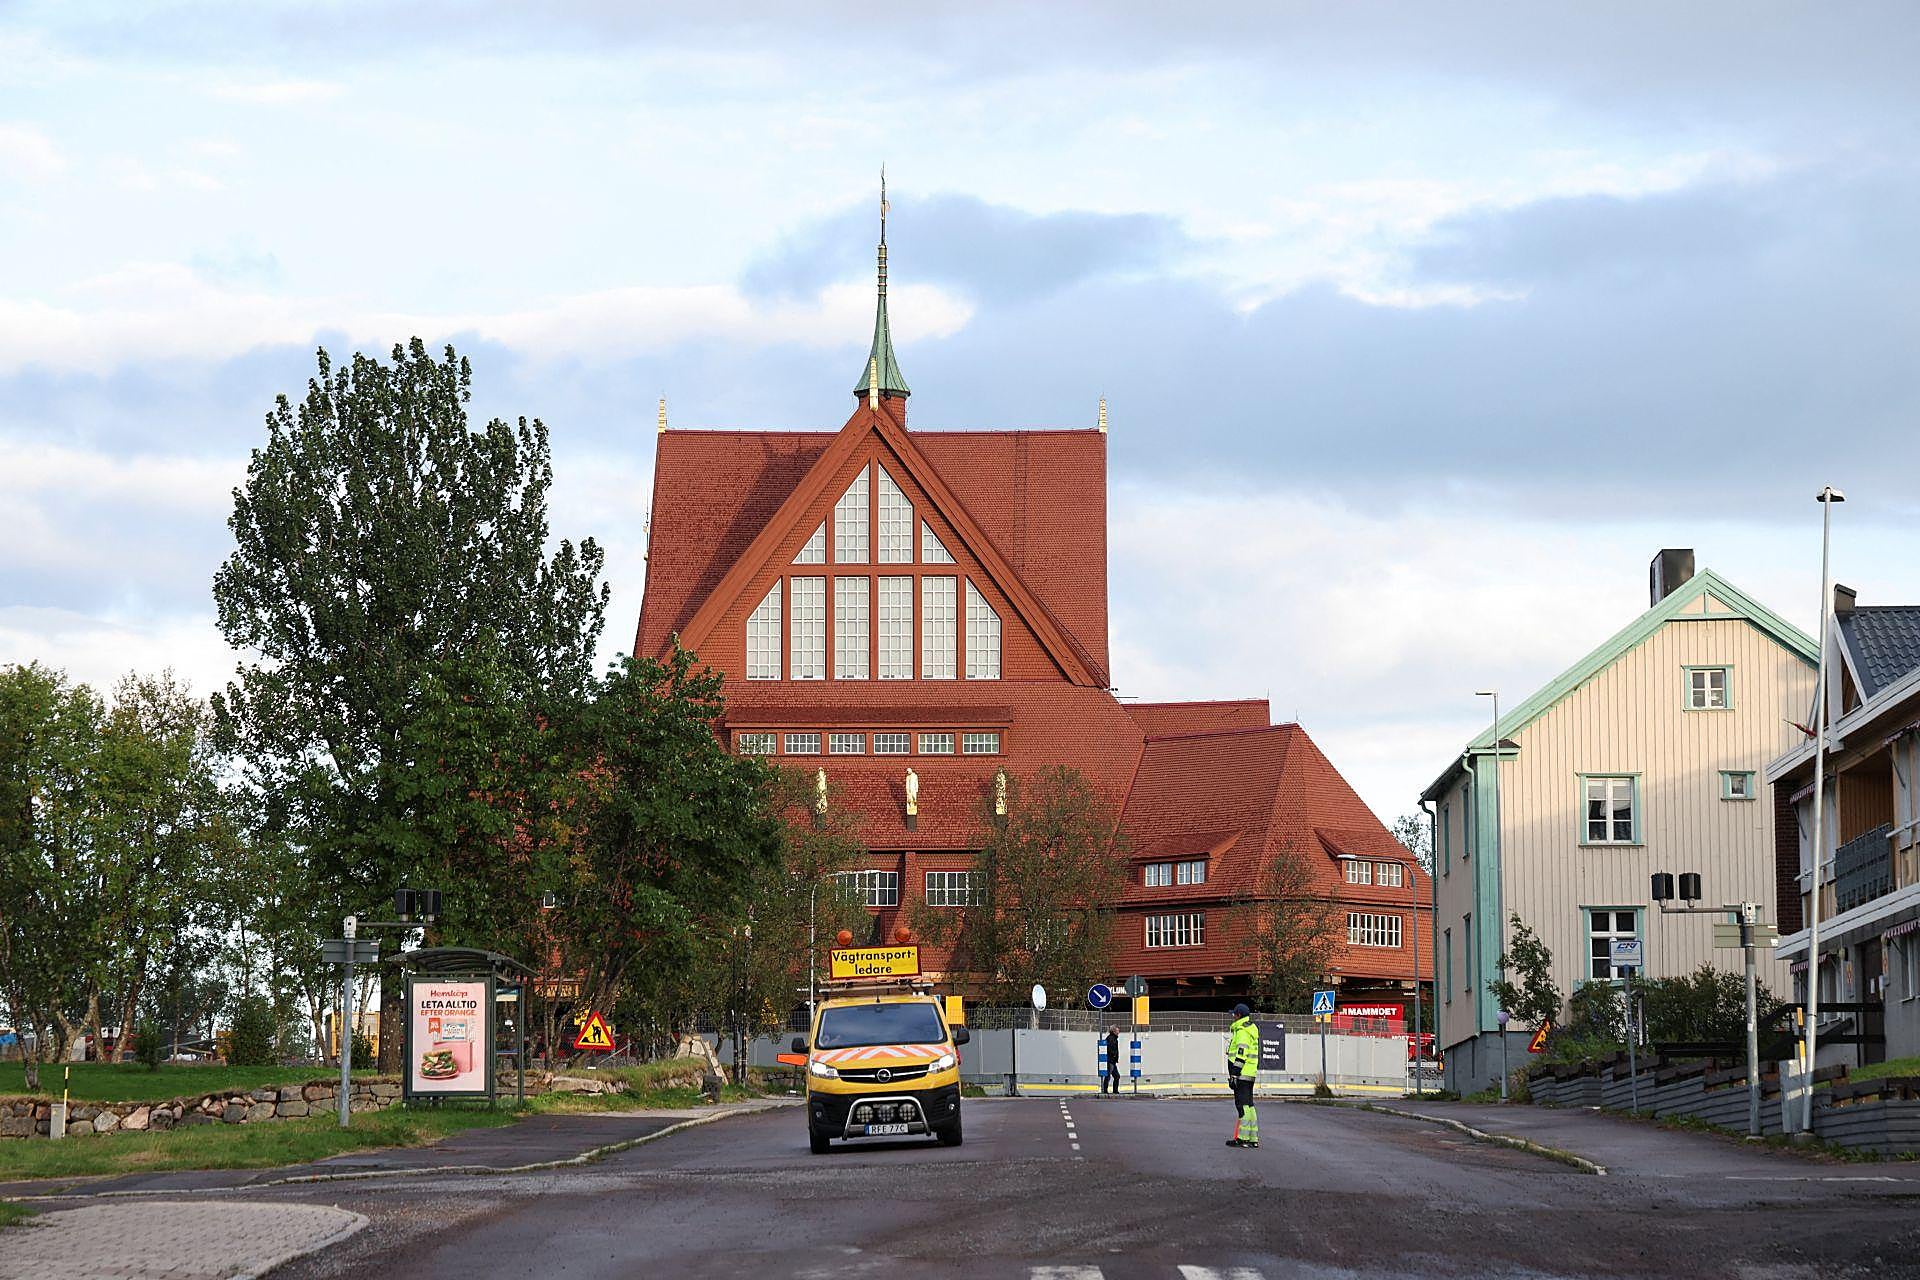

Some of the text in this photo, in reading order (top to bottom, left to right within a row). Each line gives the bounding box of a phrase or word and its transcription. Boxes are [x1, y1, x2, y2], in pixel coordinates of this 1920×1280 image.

[832, 949, 915, 964] Vägtransport-
[855, 963, 892, 975] ledare
[421, 1000, 478, 1009] LETA ALLTID
[1348, 1007, 1398, 1016] MAMMOET
